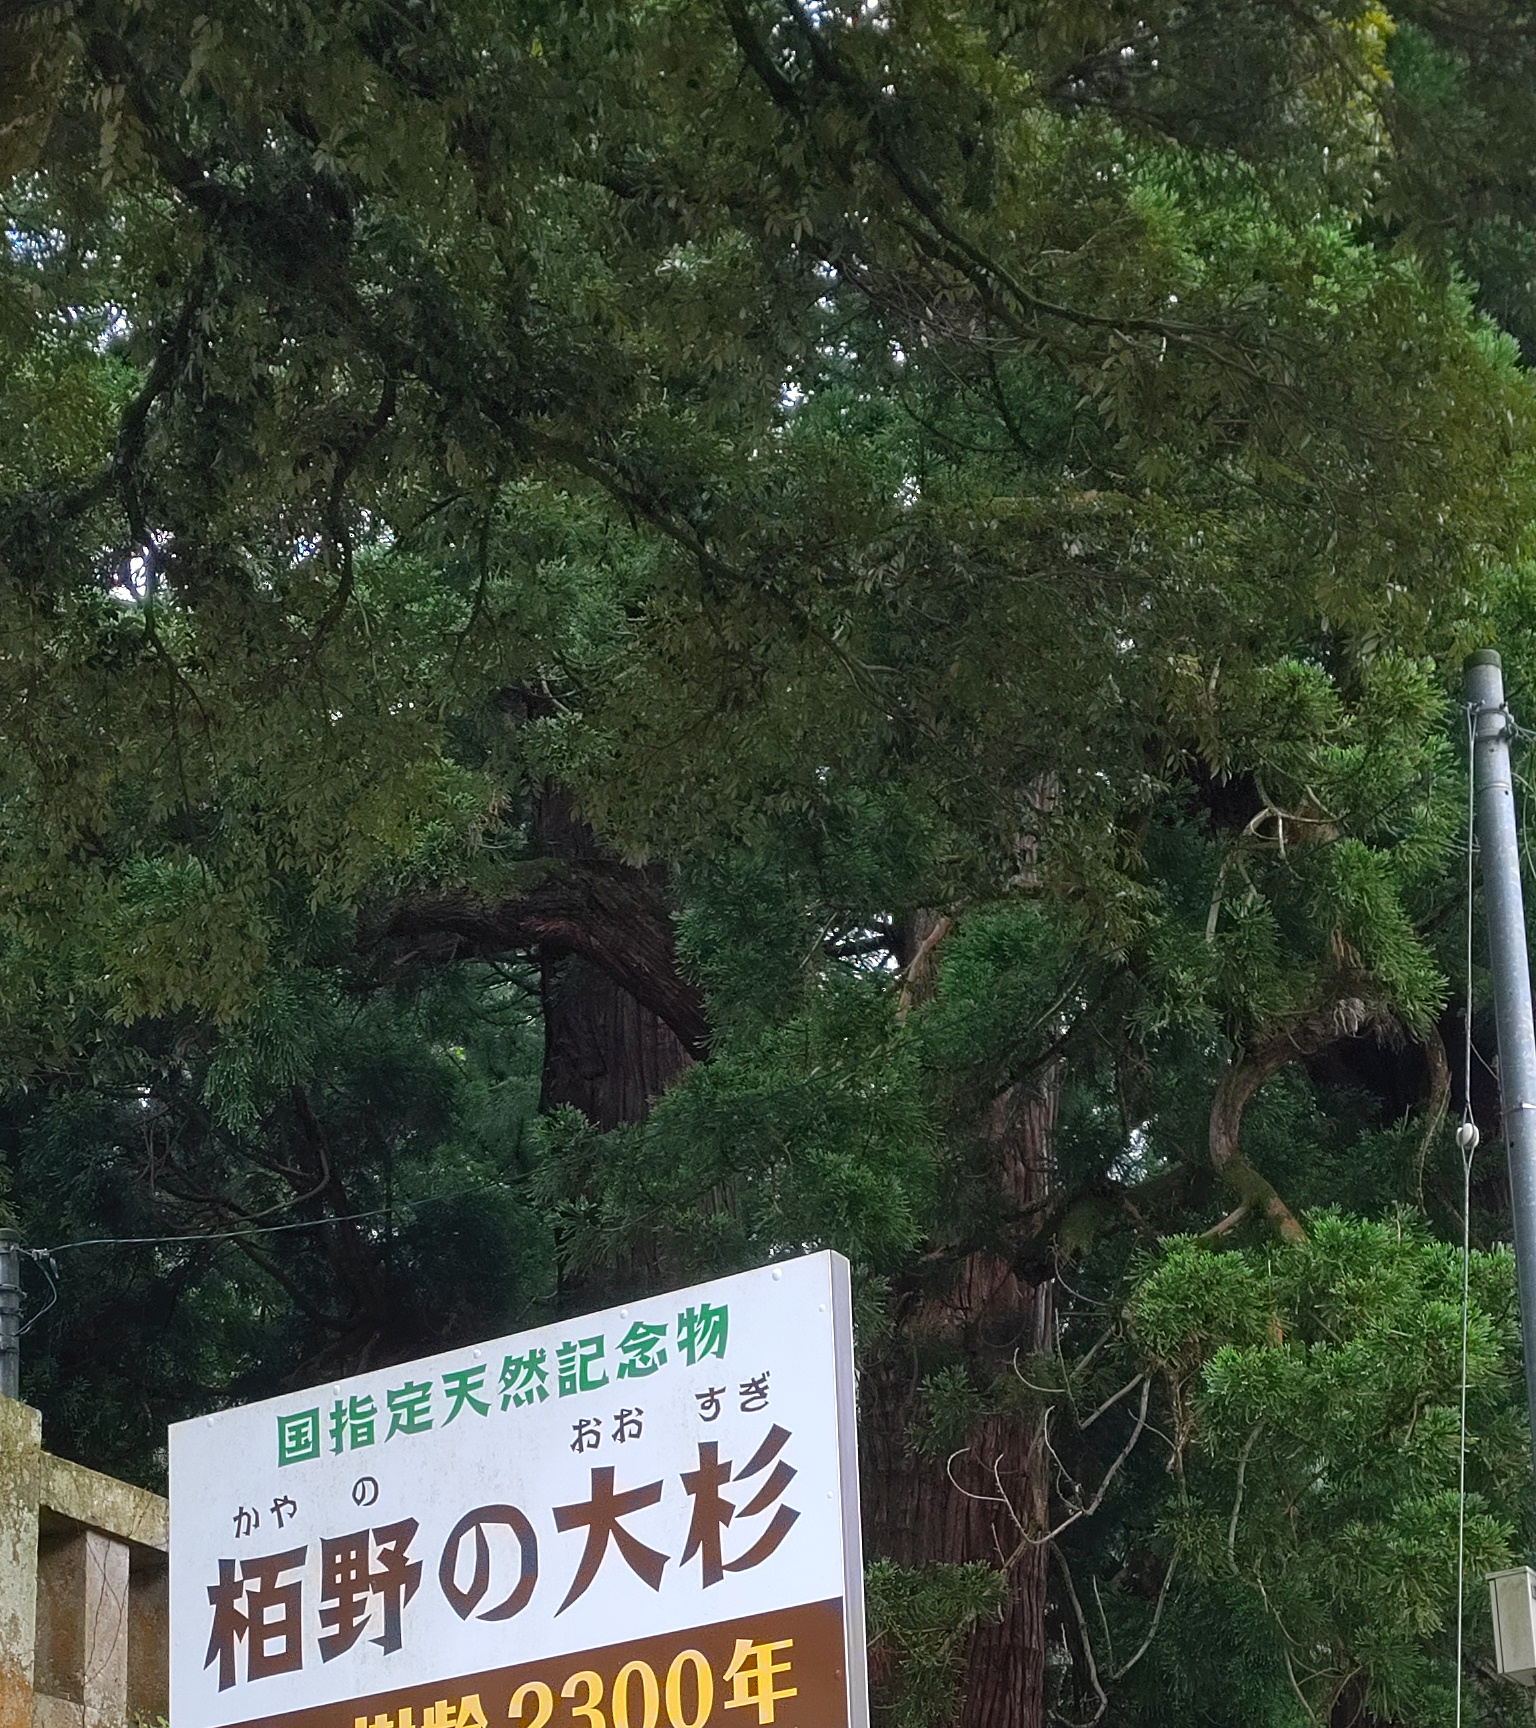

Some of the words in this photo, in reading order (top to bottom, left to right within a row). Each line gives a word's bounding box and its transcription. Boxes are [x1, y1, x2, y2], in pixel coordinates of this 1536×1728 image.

[277, 1303, 729, 1468] 国指定天然記念物
[233, 1494, 299, 1539] かや
[351, 1475, 380, 1507] の
[569, 1407, 645, 1454] おお
[203, 1423, 802, 1694] 栢野の大杉
